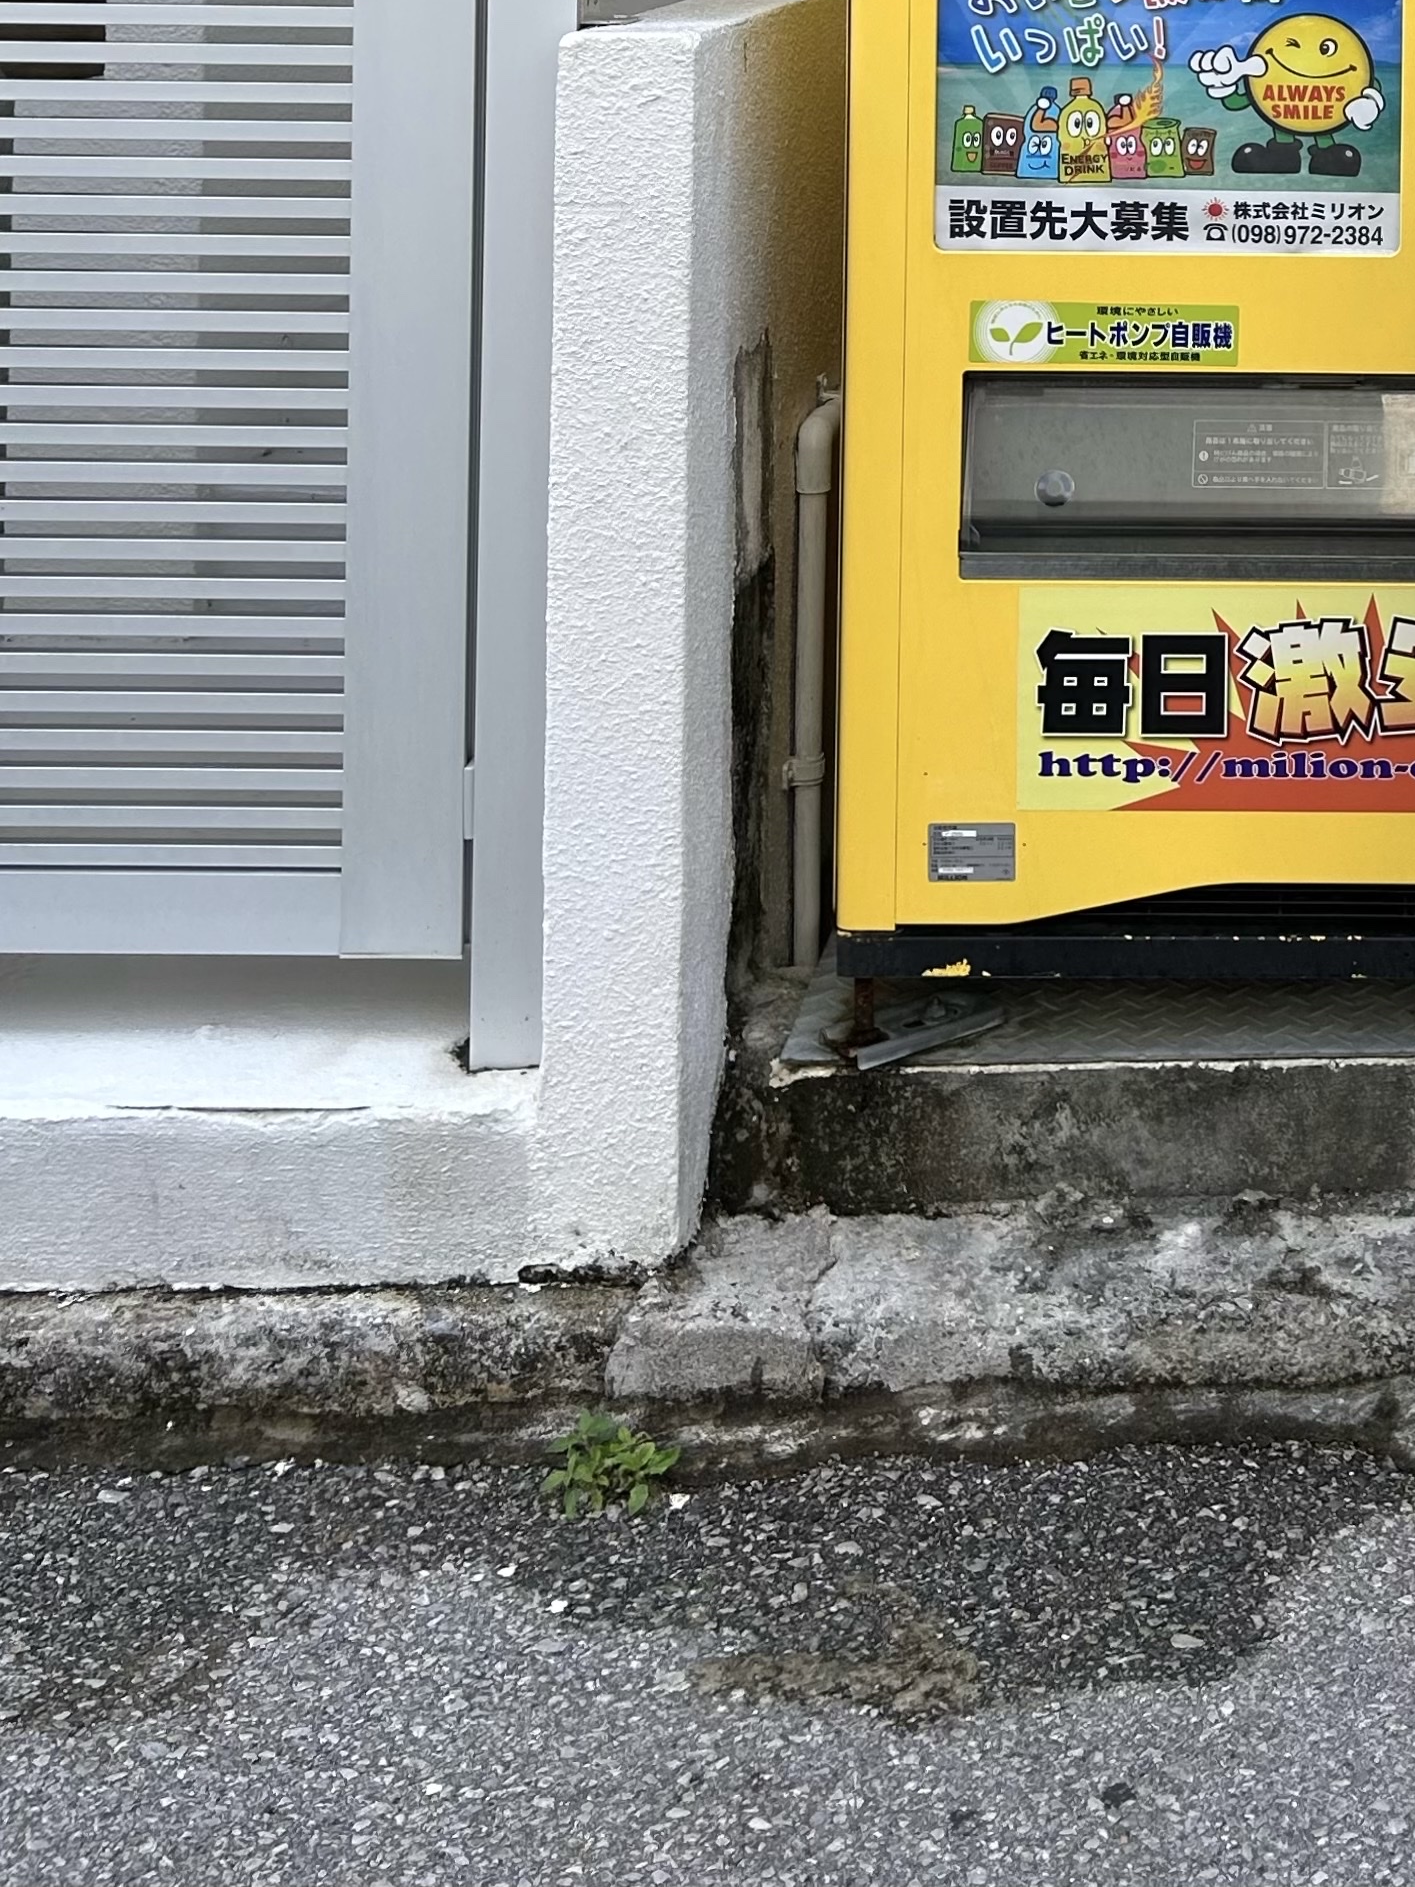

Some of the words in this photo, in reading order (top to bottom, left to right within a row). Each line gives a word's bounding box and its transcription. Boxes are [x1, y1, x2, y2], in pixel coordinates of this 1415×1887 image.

[970, 12, 1168, 74] いっぱい!
[1261, 84, 1347, 103] ALWAYS
[1270, 102, 1335, 121] SMILE
[1061, 153, 1109, 165] ENERGY
[1064, 163, 1105, 176] DRINK
[947, 197, 1190, 243] 設置先大募集
[1232, 199, 1386, 221] 株式会社ミリオン
[1231, 222, 1385, 247] (098)972-2384
[1096, 306, 1179, 317] 環境にやさしい
[1045, 320, 1234, 350] ヒートポンプ自販機
